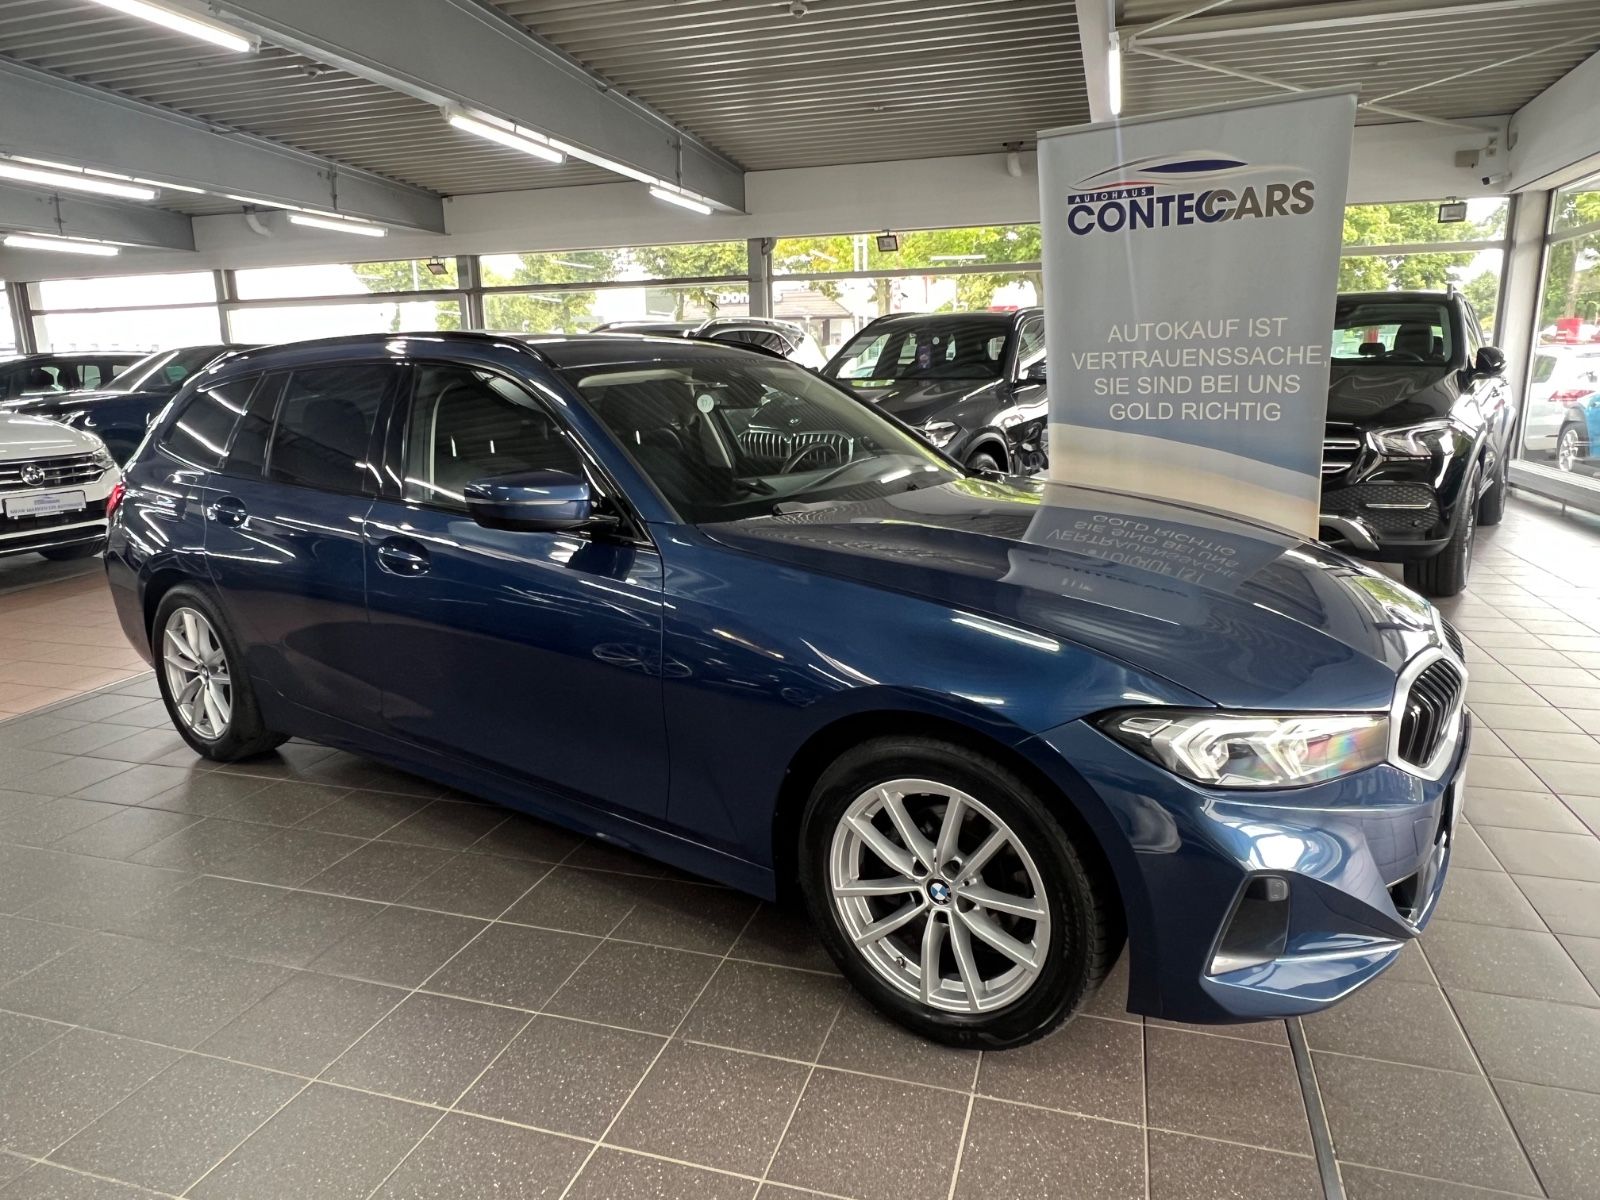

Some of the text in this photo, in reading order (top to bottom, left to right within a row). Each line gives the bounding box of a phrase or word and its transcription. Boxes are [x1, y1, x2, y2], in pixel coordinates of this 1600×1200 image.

[1074, 188, 1147, 204] AUTOHAUS
[1107, 317, 1288, 343] AUTOKAUF IST
[1071, 345, 1327, 370] VERTRAUENSSACHE,
[1094, 374, 1301, 395] SIE SIND BEI UNS
[1109, 402, 1281, 421] GOLD RICHTIG
